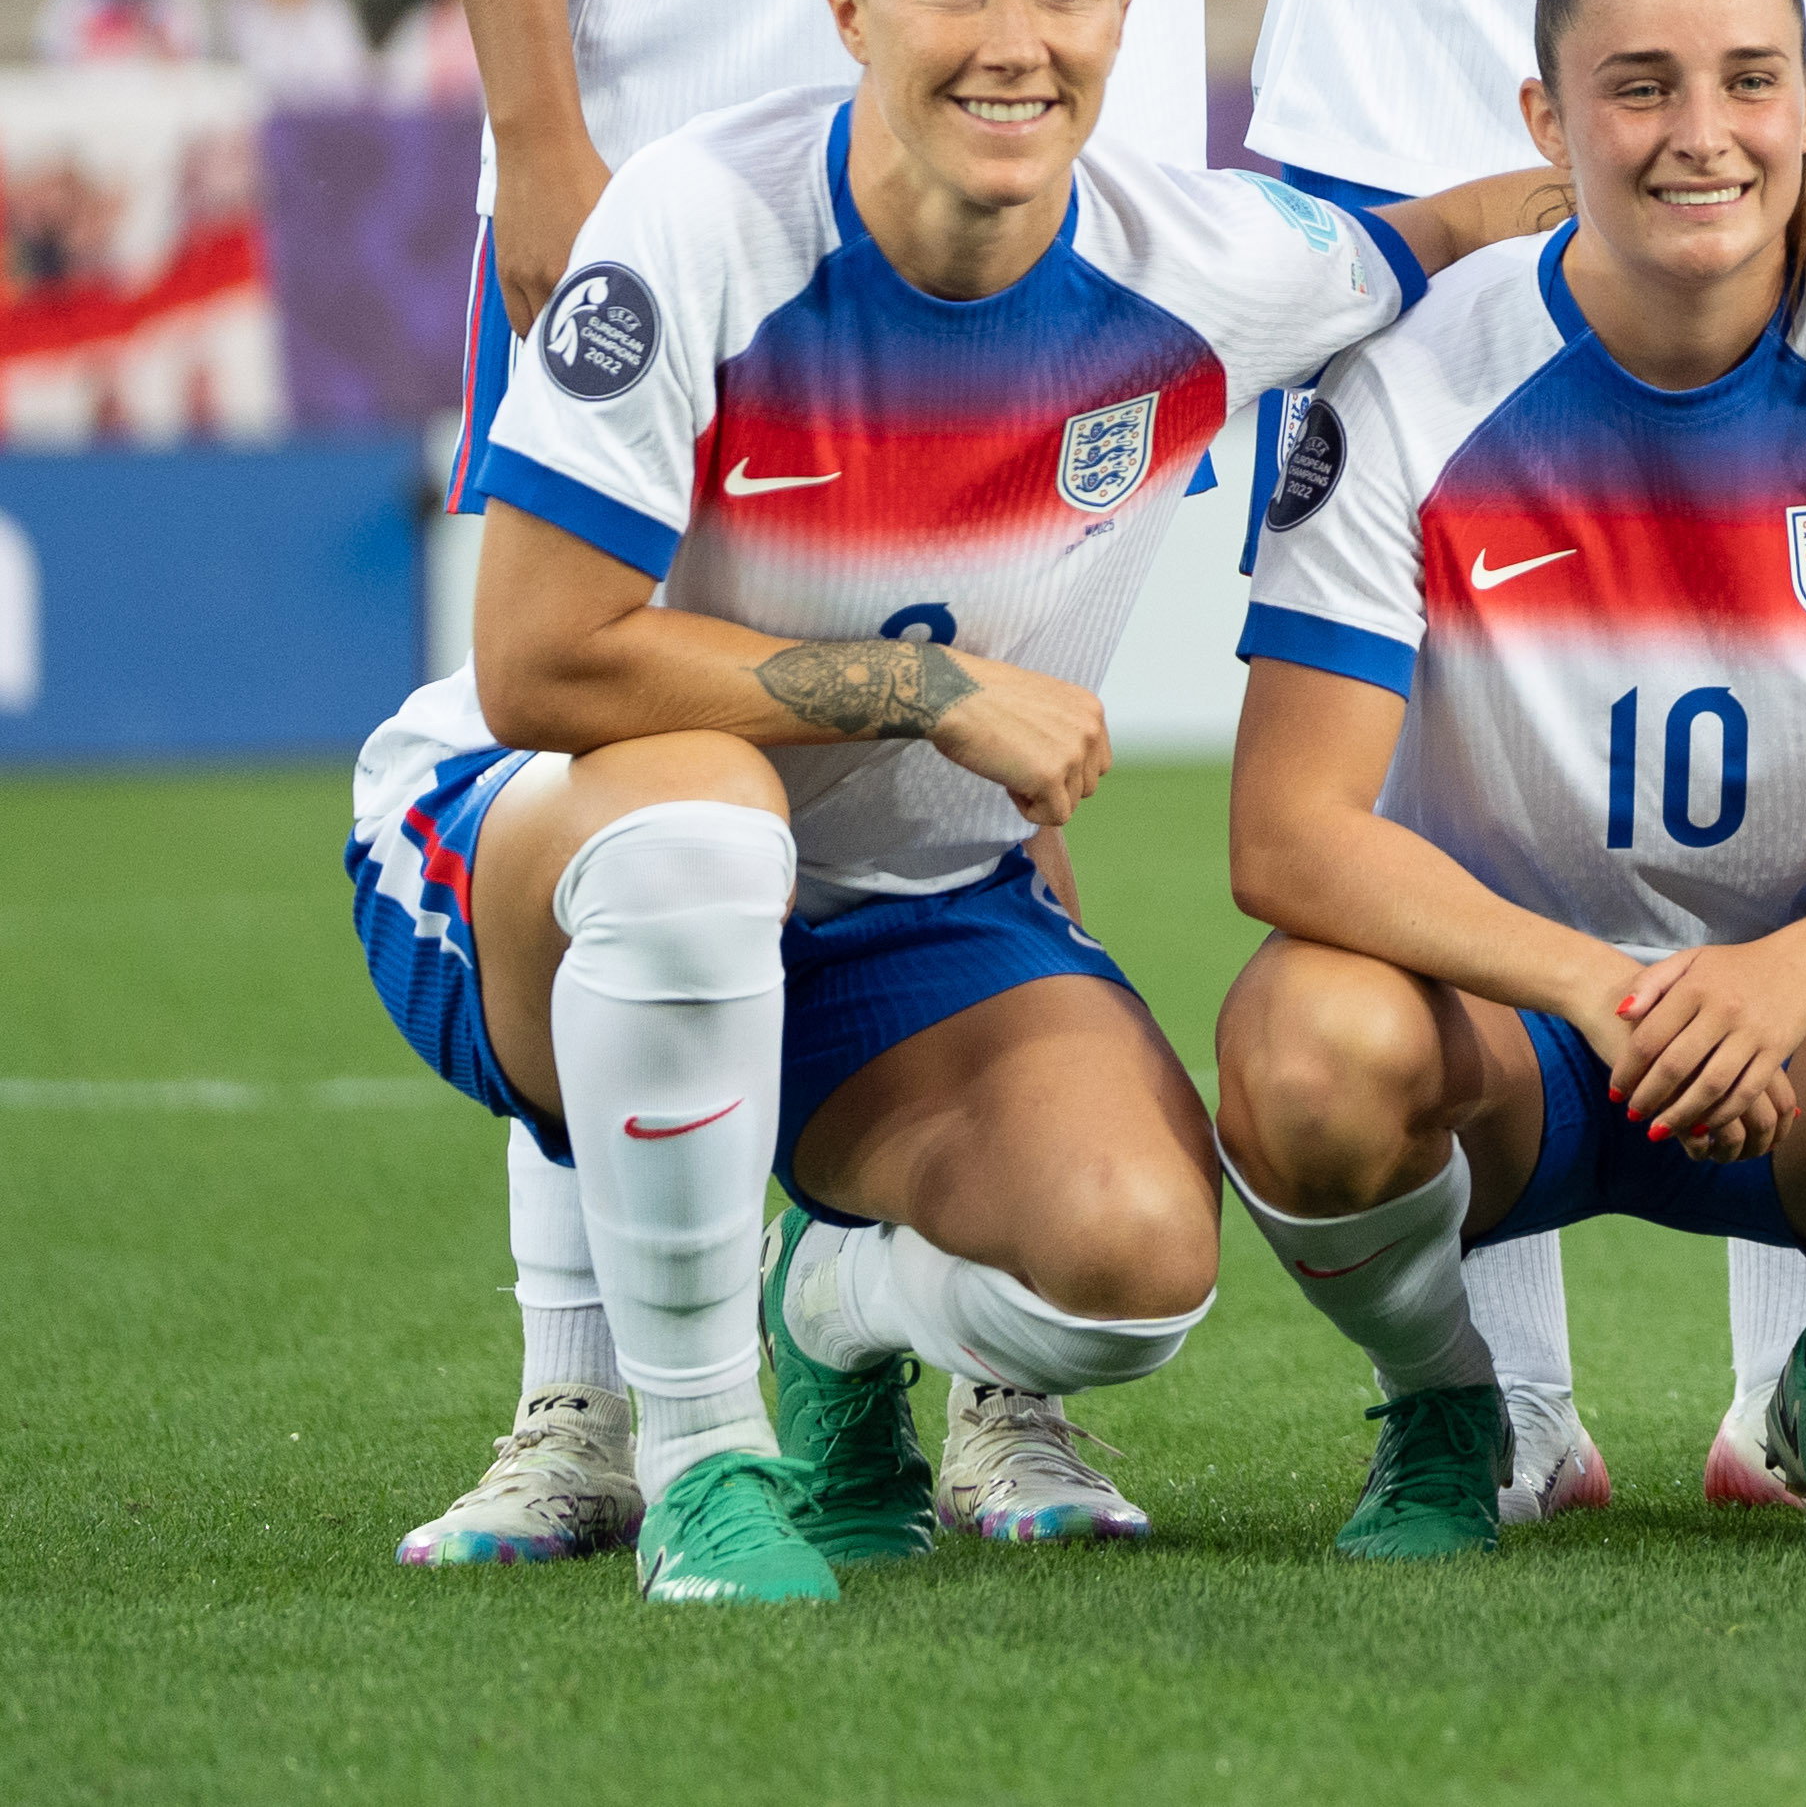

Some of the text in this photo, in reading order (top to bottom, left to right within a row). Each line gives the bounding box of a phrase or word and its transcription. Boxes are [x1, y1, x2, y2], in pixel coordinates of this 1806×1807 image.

[607, 306, 642, 332] UEFA
[580, 326, 642, 366] CHAMPIONS
[588, 316, 645, 353] EUROPEAN
[584, 347, 623, 376] 2022
[1305, 437, 1330, 457] UEFA
[1289, 465, 1329, 487] CHAMPIONS
[1295, 454, 1332, 474] EUROPEAN
[1287, 480, 1313, 499] 2022
[1606, 686, 1749, 850] 10
